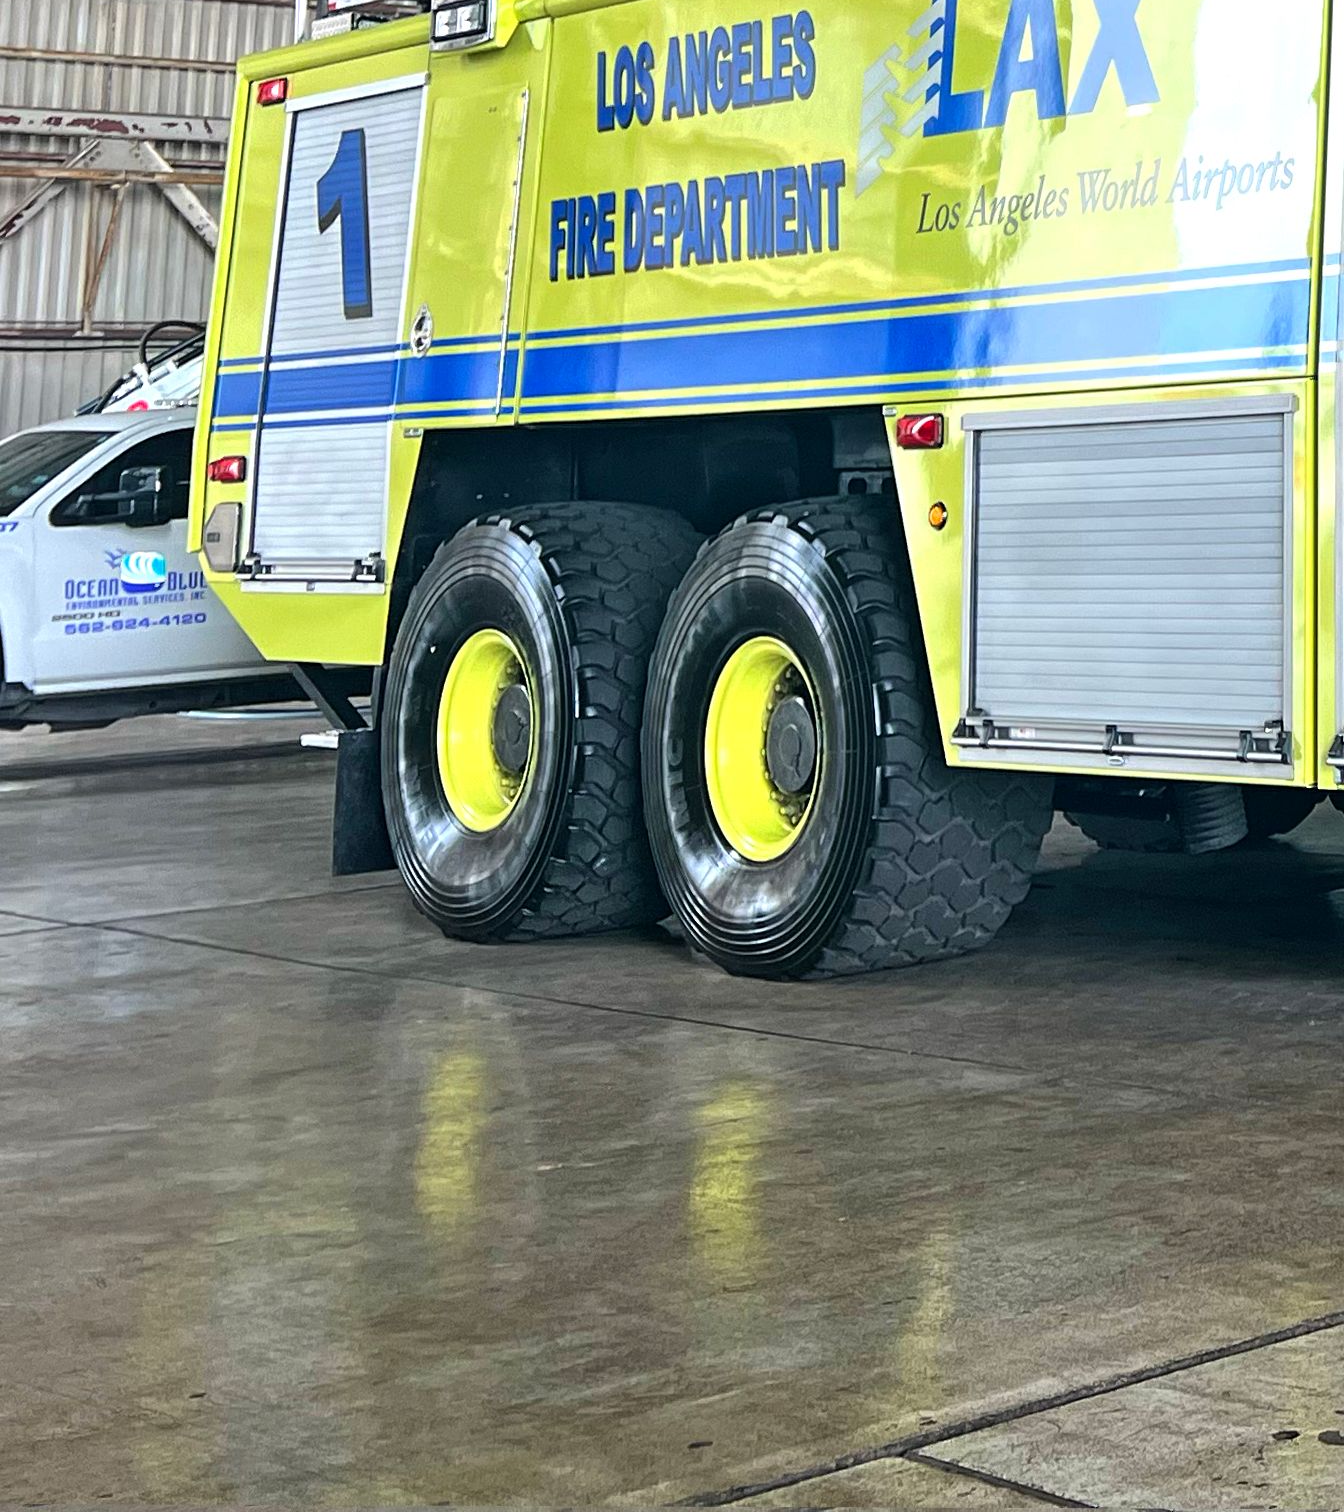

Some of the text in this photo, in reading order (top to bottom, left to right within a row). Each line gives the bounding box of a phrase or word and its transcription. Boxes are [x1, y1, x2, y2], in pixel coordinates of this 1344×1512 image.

[596, 10, 816, 132] LOS ANGELES
[316, 127, 373, 321] 1
[549, 159, 846, 282] FIRE DEPARTMENT
[916, 149, 1296, 236] Los Angeles World Airports
[64, 578, 119, 600] OCEAN
